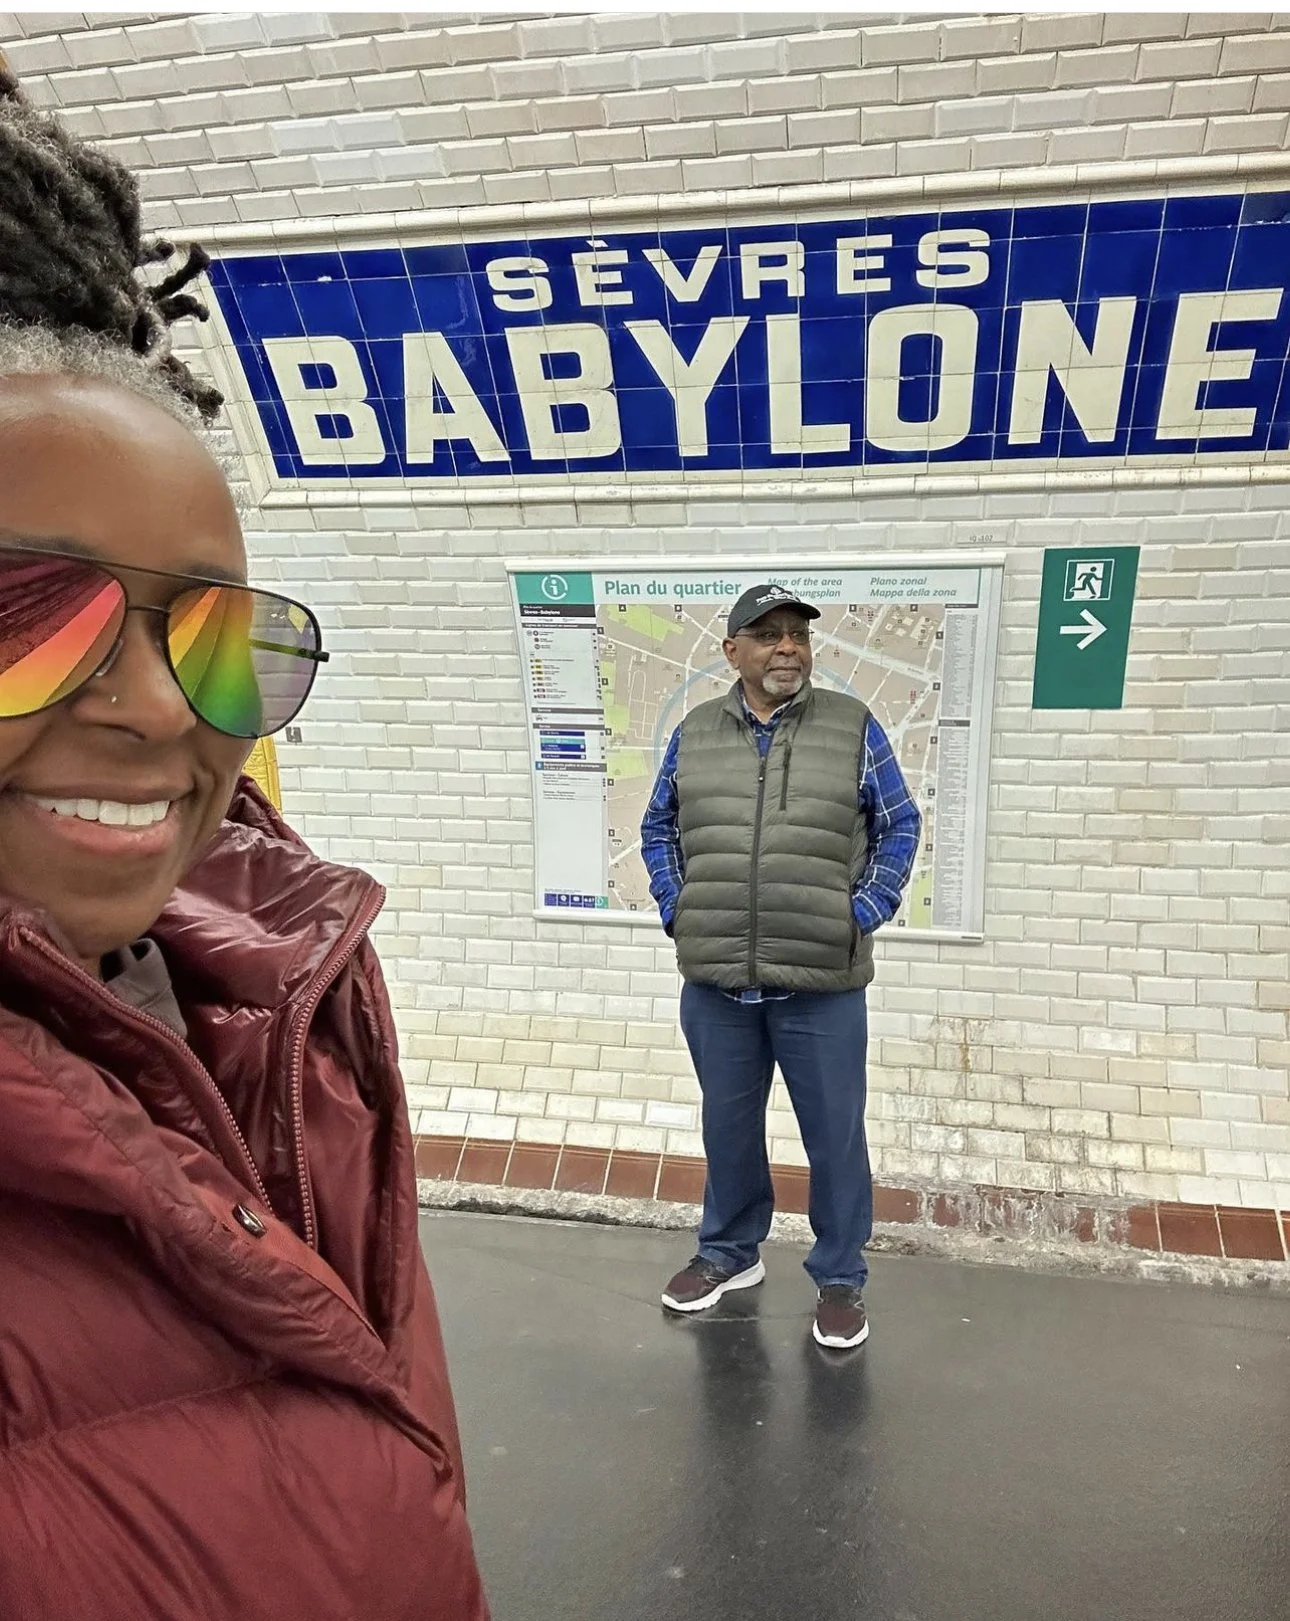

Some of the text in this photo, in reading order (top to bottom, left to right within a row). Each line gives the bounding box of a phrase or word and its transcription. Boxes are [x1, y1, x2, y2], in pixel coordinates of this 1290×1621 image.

[486, 229, 991, 313] SÈVRES
[261, 288, 1285, 466] BABYLONE
[768, 578, 788, 587] Map
[791, 577, 803, 586] of
[803, 577, 818, 586] the
[870, 577, 928, 586] Plano zonal
[605, 580, 640, 595] Plan
[646, 580, 667, 595] du
[673, 580, 742, 598] quartier
[870, 588, 957, 598] Mappa della zona
